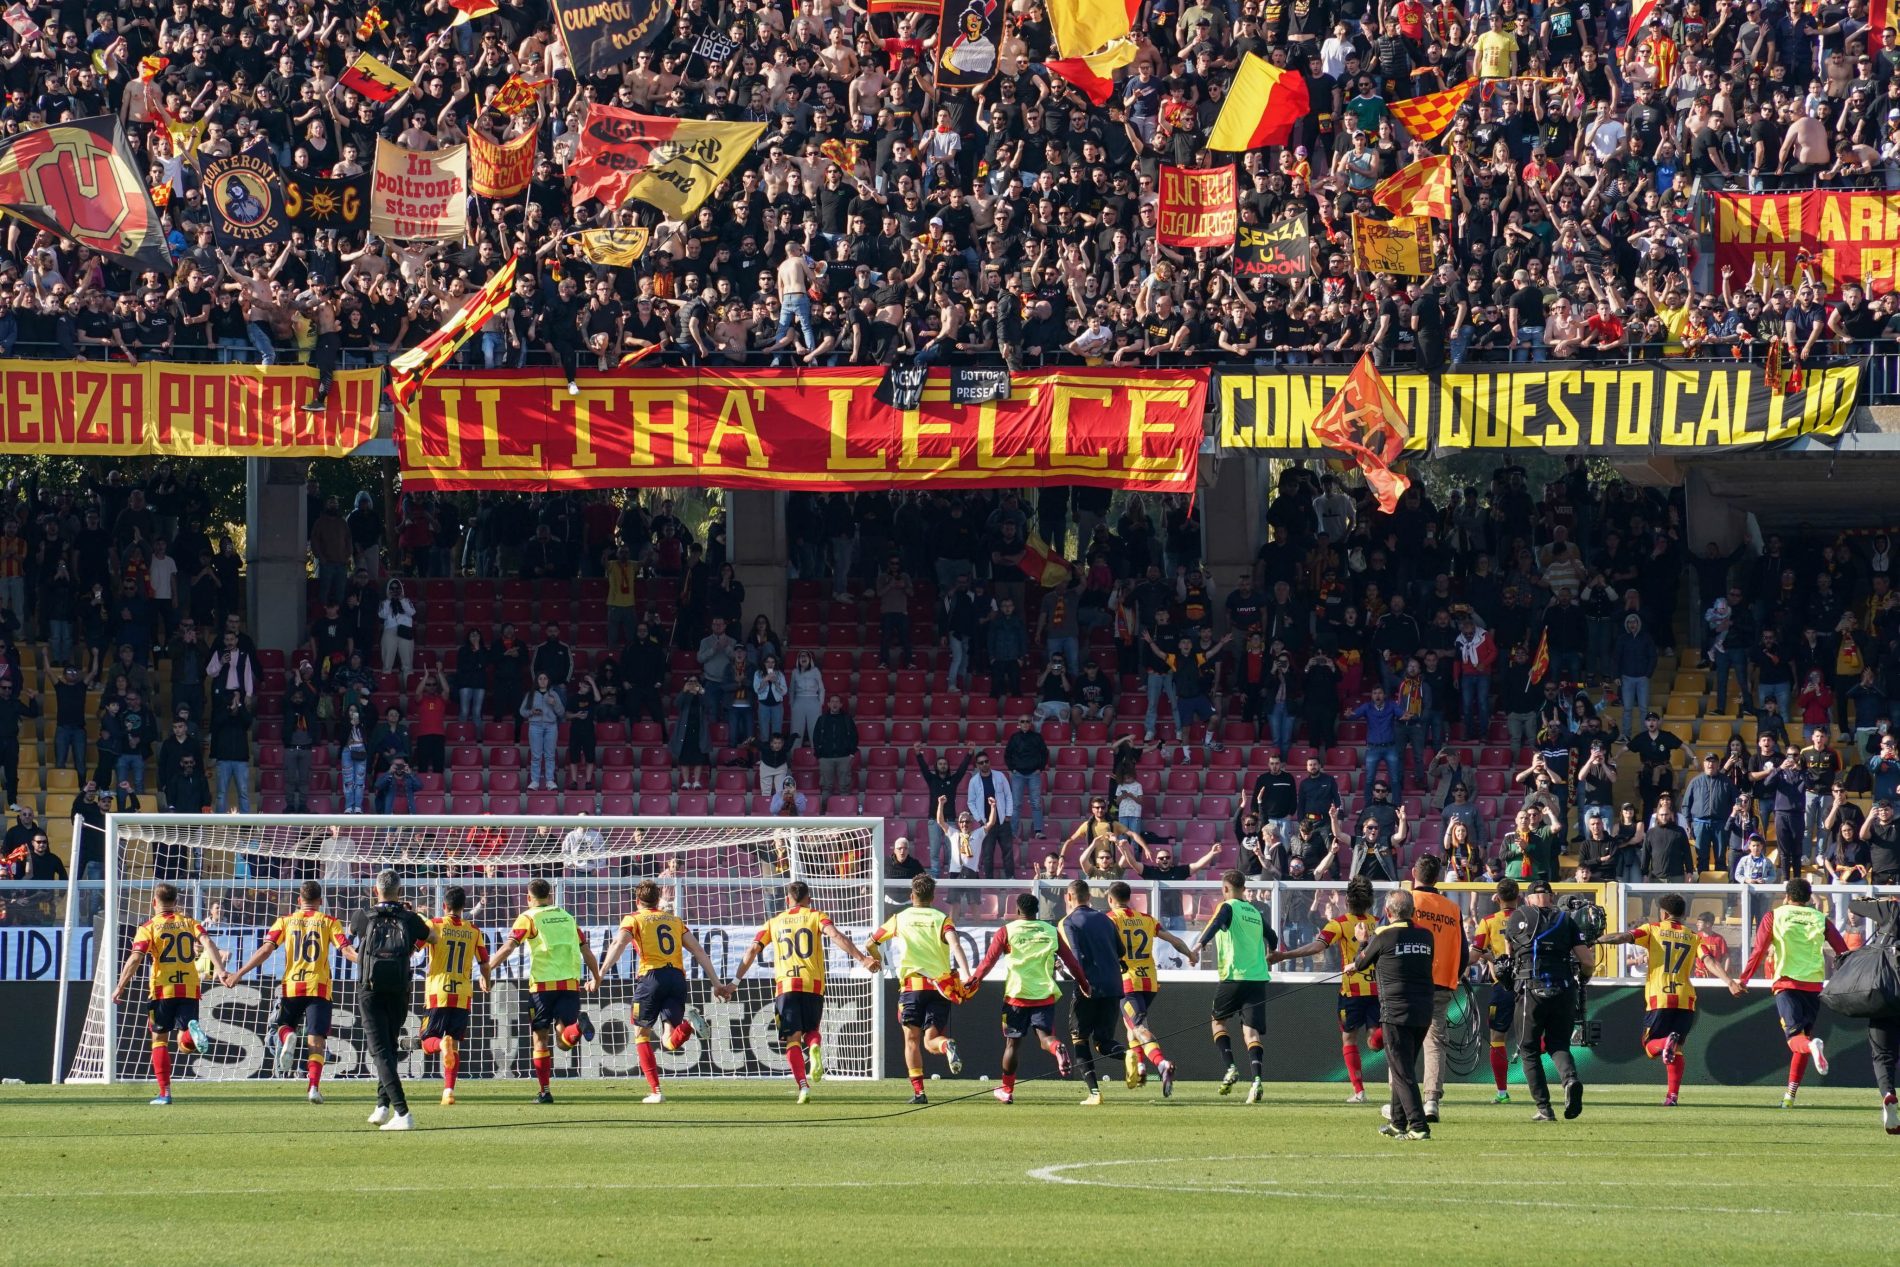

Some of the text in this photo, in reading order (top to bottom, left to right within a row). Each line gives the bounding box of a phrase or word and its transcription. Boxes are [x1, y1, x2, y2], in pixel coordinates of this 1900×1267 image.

[203, 155, 276, 189] MONTERONI
[407, 153, 432, 176] In
[376, 170, 463, 198] poltrona
[1164, 170, 1233, 207] INFERNO
[385, 199, 449, 219] stacci
[1161, 208, 1237, 238] GIALLOROSSO
[1720, 195, 1802, 243] MAI
[222, 216, 280, 240] ULTRAS
[1239, 217, 1307, 247] SENZA
[1234, 254, 1307, 275] PADRONI
[0, 371, 374, 448] ENZA PADRONI
[1660, 365, 1861, 447] CALCIO
[826, 385, 1189, 470] LECCE
[442, 928, 473, 940] SANSONE
[656, 923, 676, 956] 6
[1432, 923, 1443, 933] TV
[1659, 930, 1693, 941] GENDREY
[159, 931, 195, 964] 20
[291, 930, 322, 963] 16
[446, 940, 467, 974] 11
[777, 927, 814, 961] 50
[1122, 928, 1150, 961] 12
[1394, 944, 1432, 956] LECCE
[1661, 940, 1692, 974] 17
[168, 971, 190, 984] dr
[291, 968, 315, 982] dr
[785, 965, 807, 978] dr
[442, 980, 463, 994] dr
[1662, 981, 1685, 994] dr
